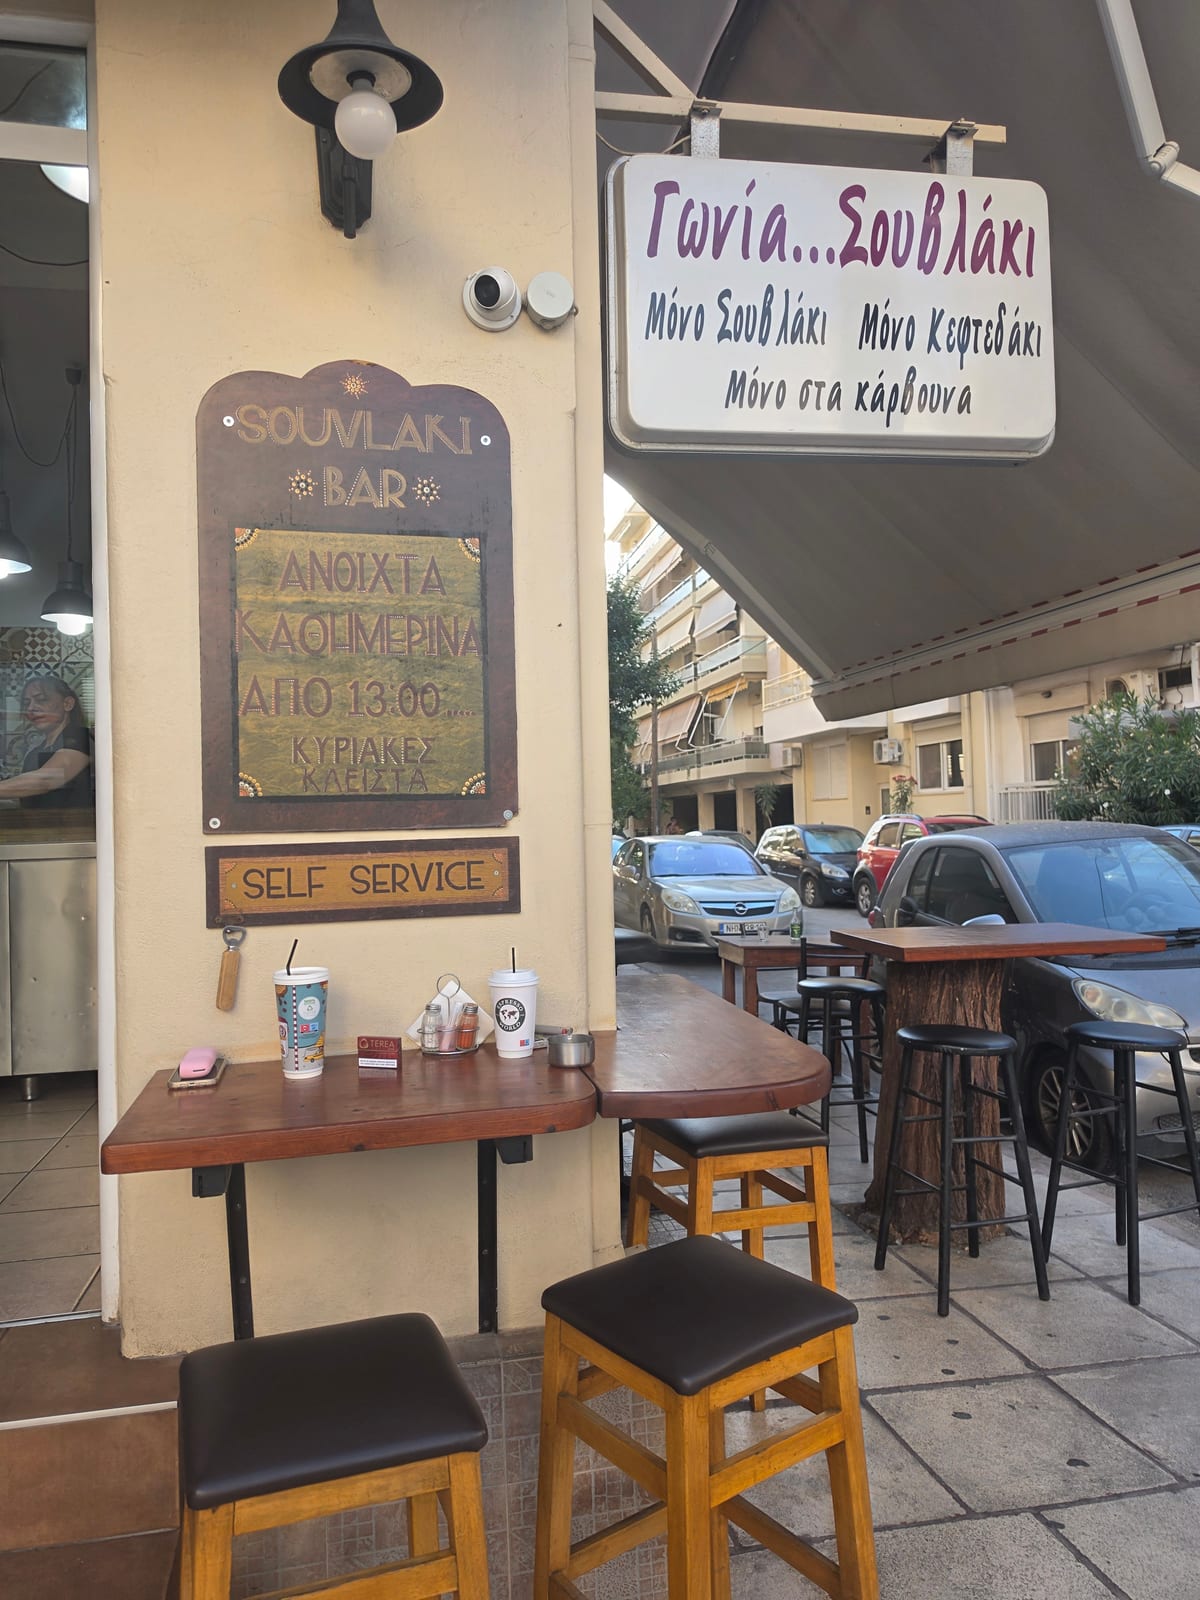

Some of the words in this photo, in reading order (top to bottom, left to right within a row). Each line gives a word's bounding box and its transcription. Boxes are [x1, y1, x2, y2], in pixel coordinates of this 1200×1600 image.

[644, 286, 706, 342] Μόνο
[716, 283, 827, 347] Σουβλάκι
[858, 298, 916, 353] Μόνο
[926, 301, 1042, 370] Κεφτεδάκι
[724, 365, 787, 411] Μόνο
[799, 379, 842, 412] στα
[854, 366, 972, 427] κάρβουνα
[235, 403, 473, 455] SOUVLAKI
[323, 465, 408, 509] BAR
[278, 549, 447, 597] ΑΝΟΙΧΤΑ
[234, 609, 481, 657] ΚΑΘΗΜΕΡΙΝΑ
[238, 674, 333, 718] ΑΠΟ
[291, 736, 438, 765] ΚΥΡΙΑΚΕΣ
[302, 768, 429, 793] ΚΛΕΙΣΤΑ
[242, 865, 327, 899] SELF
[349, 860, 485, 895] SERVICE
[370, 1039, 395, 1049] TEREA
